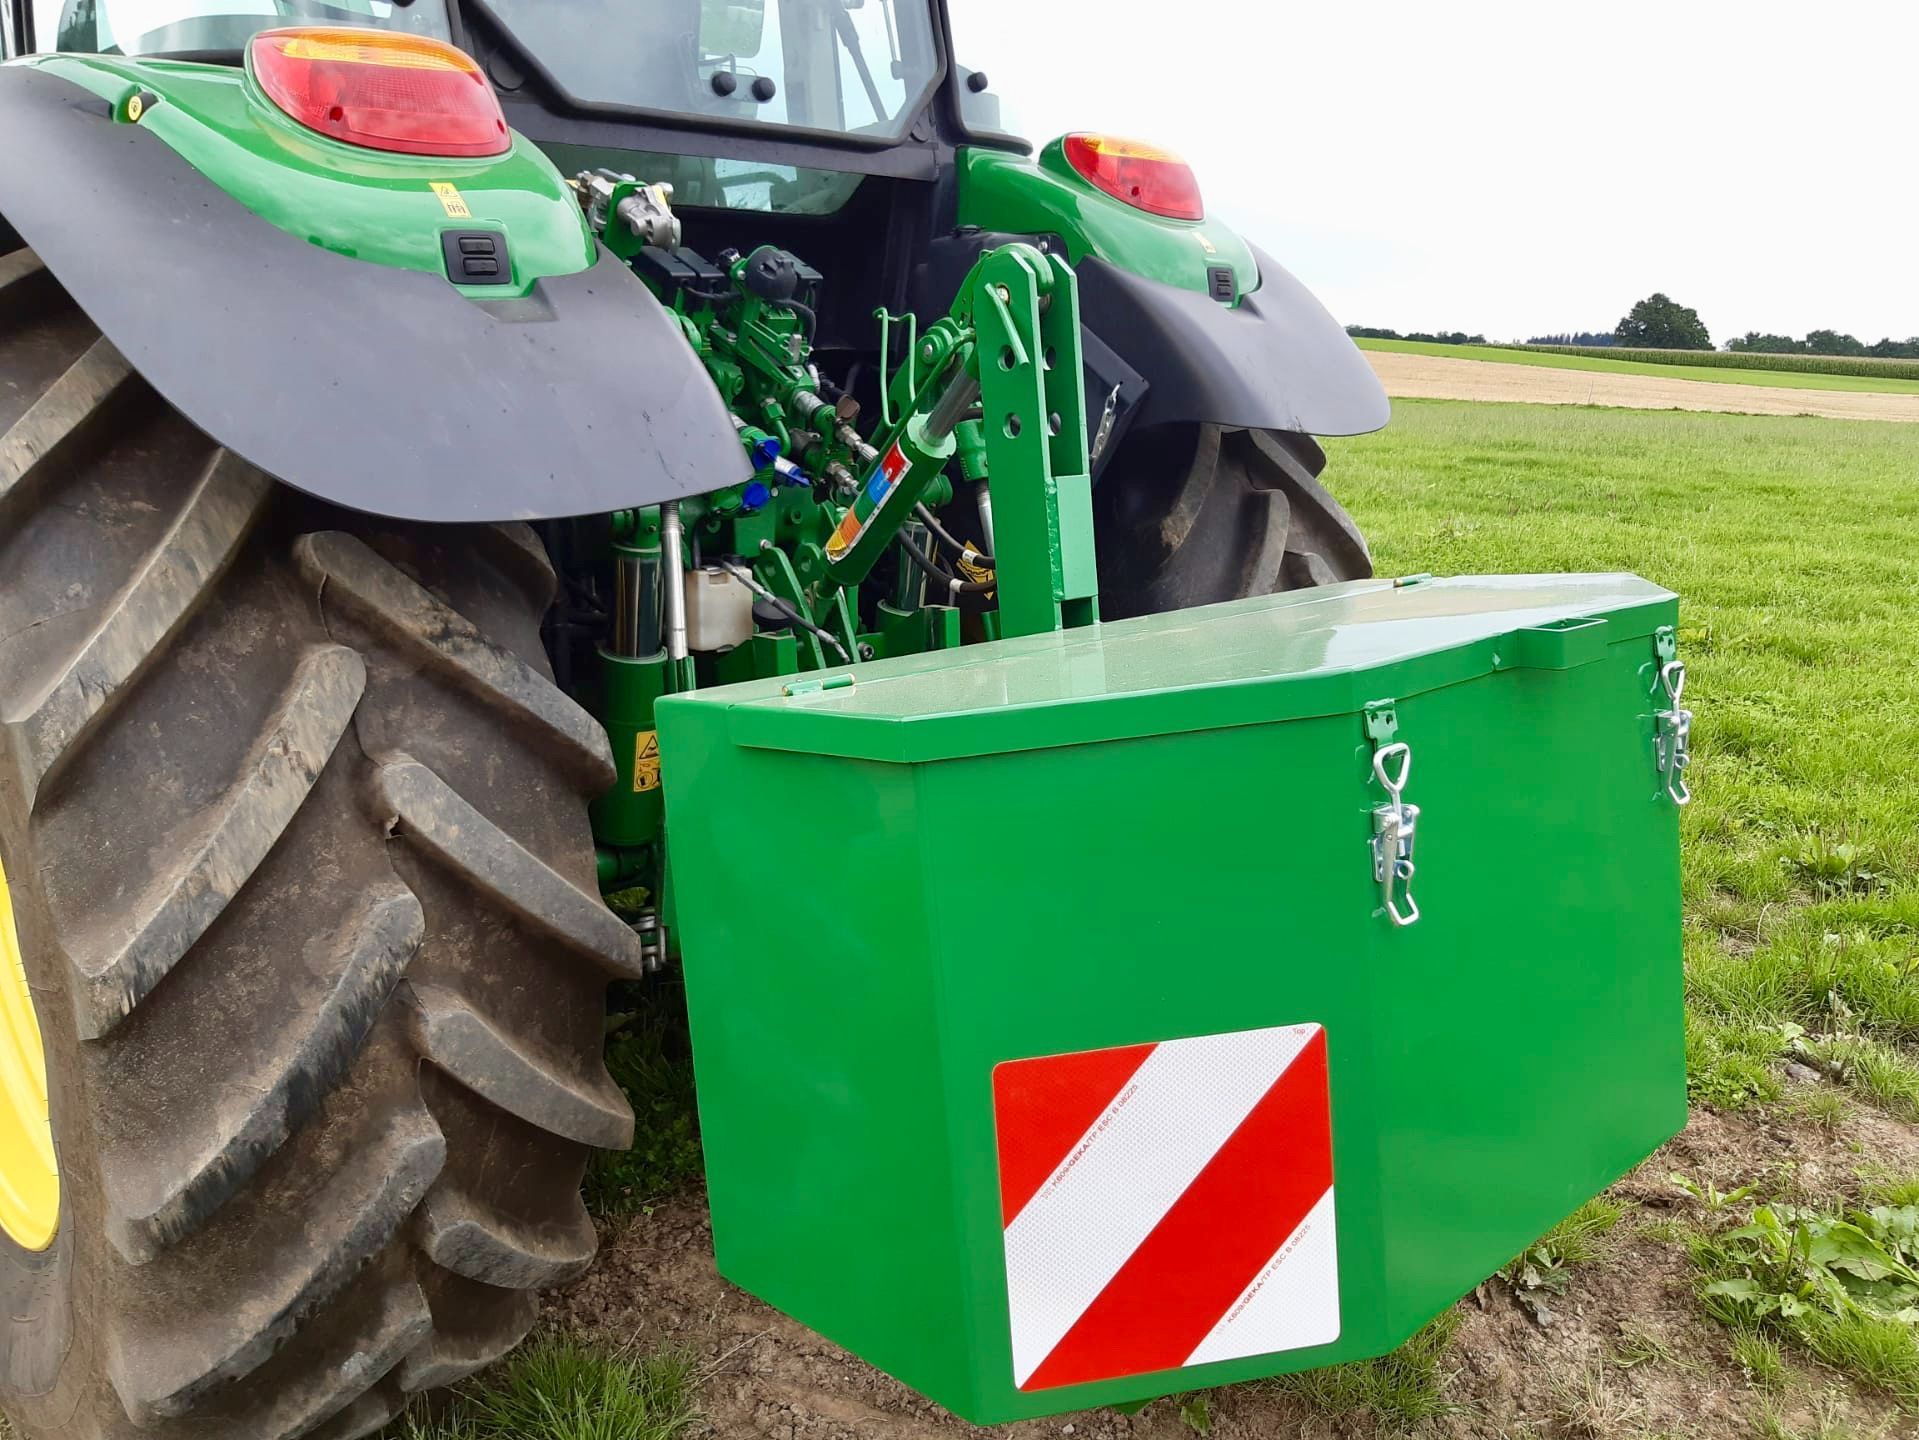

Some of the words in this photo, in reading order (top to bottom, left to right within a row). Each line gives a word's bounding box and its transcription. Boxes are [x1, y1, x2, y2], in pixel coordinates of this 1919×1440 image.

[1097, 1113, 1114, 1132] ESC
[1111, 1105, 1119, 1114] B
[1270, 1252, 1287, 1270] ESC
